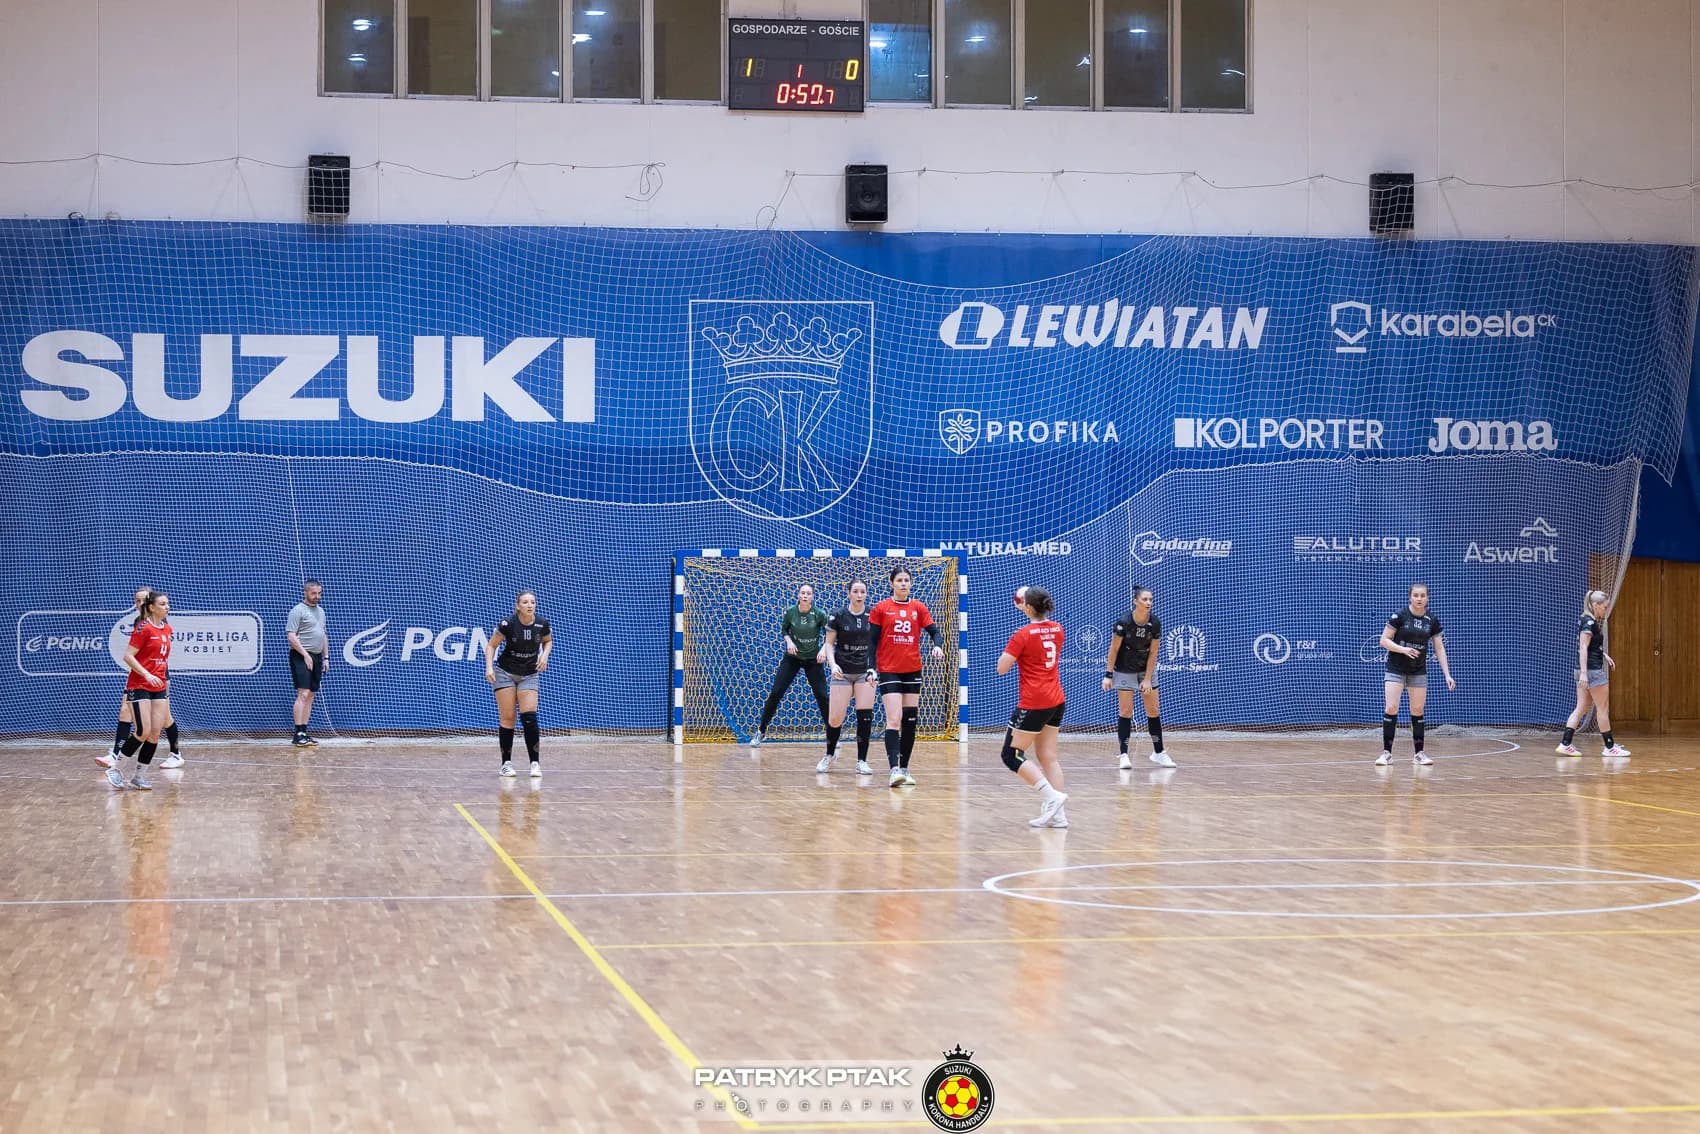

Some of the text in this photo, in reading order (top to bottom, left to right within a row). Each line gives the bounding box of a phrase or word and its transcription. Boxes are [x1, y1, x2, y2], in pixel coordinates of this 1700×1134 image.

[732, 24, 807, 35] GOSPODARZE
[819, 24, 860, 36] GOŚCIE
[746, 58, 753, 77] 1
[797, 64, 803, 78] 1
[845, 59, 859, 80] 0
[1008, 298, 1269, 349] LEWIATAN
[1381, 308, 1534, 338] karabela
[20, 329, 596, 423] SUZUKI
[709, 387, 840, 492] CK
[987, 421, 1119, 443] PROFIKA
[1196, 418, 1384, 450] KOLPORTER
[1428, 418, 1558, 453] Joma
[939, 541, 1072, 555] NATURAL-MED
[1141, 538, 1232, 550] endorfina
[1312, 536, 1421, 551] ALUTOR
[1464, 542, 1558, 563] Aswent
[893, 620, 912, 633] 28
[1413, 618, 1423, 629] 32
[169, 631, 250, 643] SUPERLIGA
[523, 629, 532, 641] 18
[1136, 627, 1146, 638] 22
[47, 636, 104, 650] PGNiG
[183, 645, 233, 653] KOBIET
[401, 627, 498, 661] PGN
[1043, 640, 1056, 669] 3
[1155, 661, 1219, 673] usar-Sport
